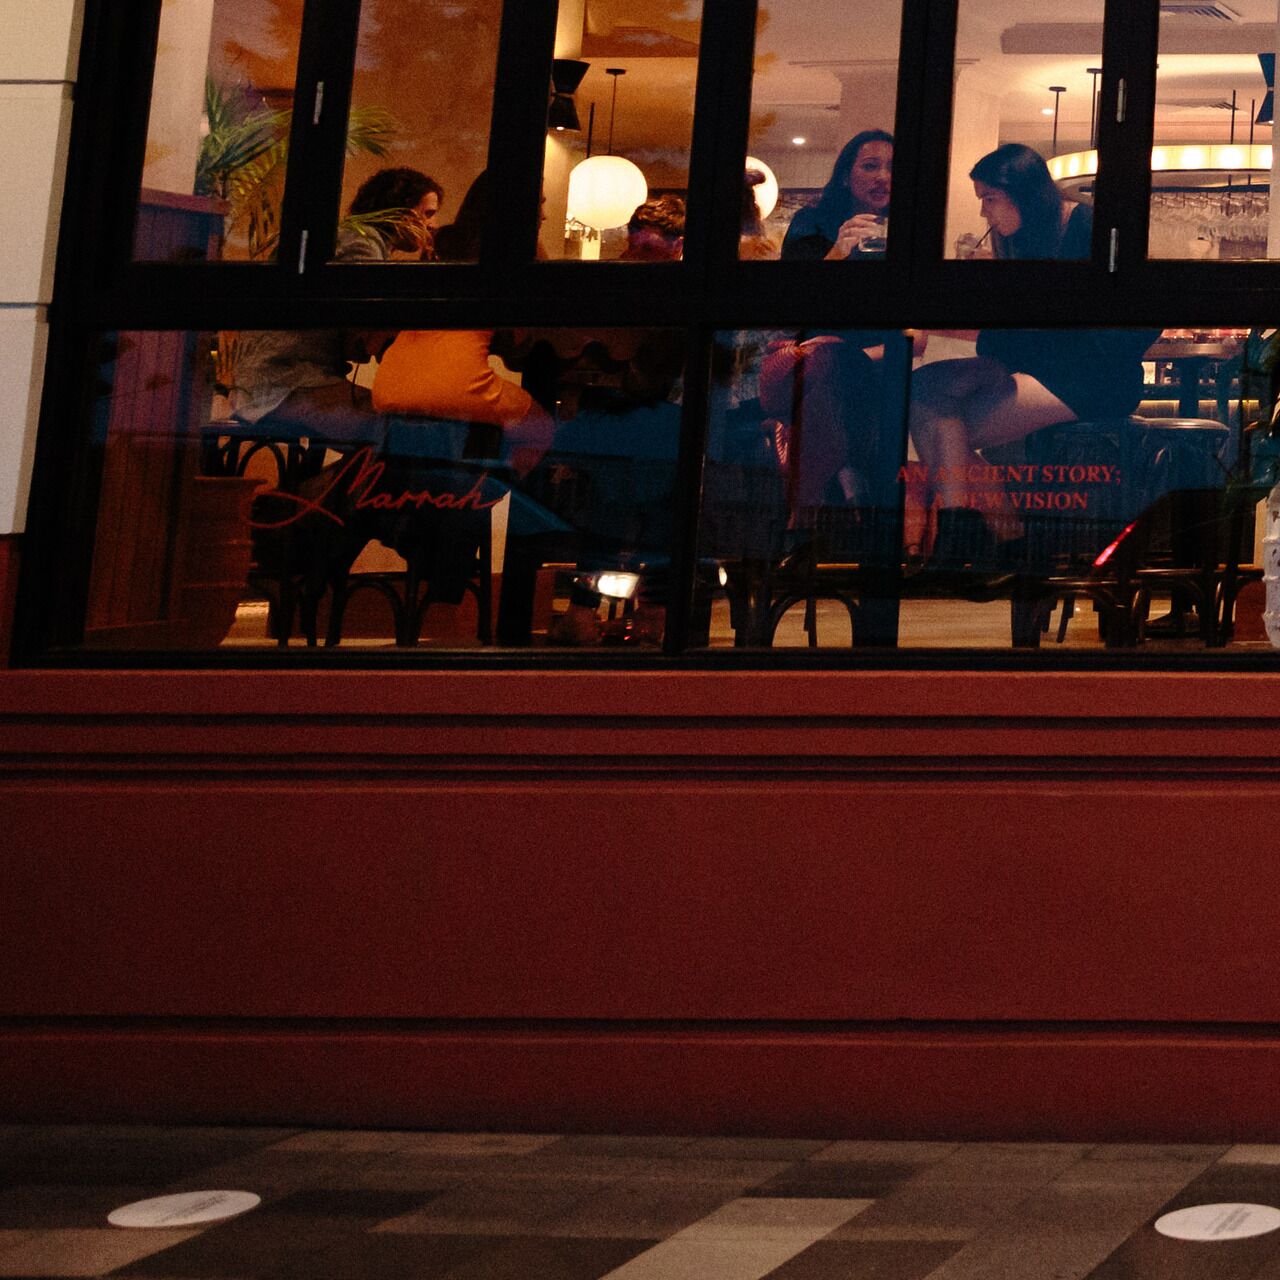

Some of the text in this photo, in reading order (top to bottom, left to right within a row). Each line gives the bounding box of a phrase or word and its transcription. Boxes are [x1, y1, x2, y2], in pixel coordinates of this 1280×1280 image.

[897, 464, 1121, 486] AN ANCIENT STORY;
[246, 445, 507, 528] Marrah
[1010, 491, 1089, 510] VISION
